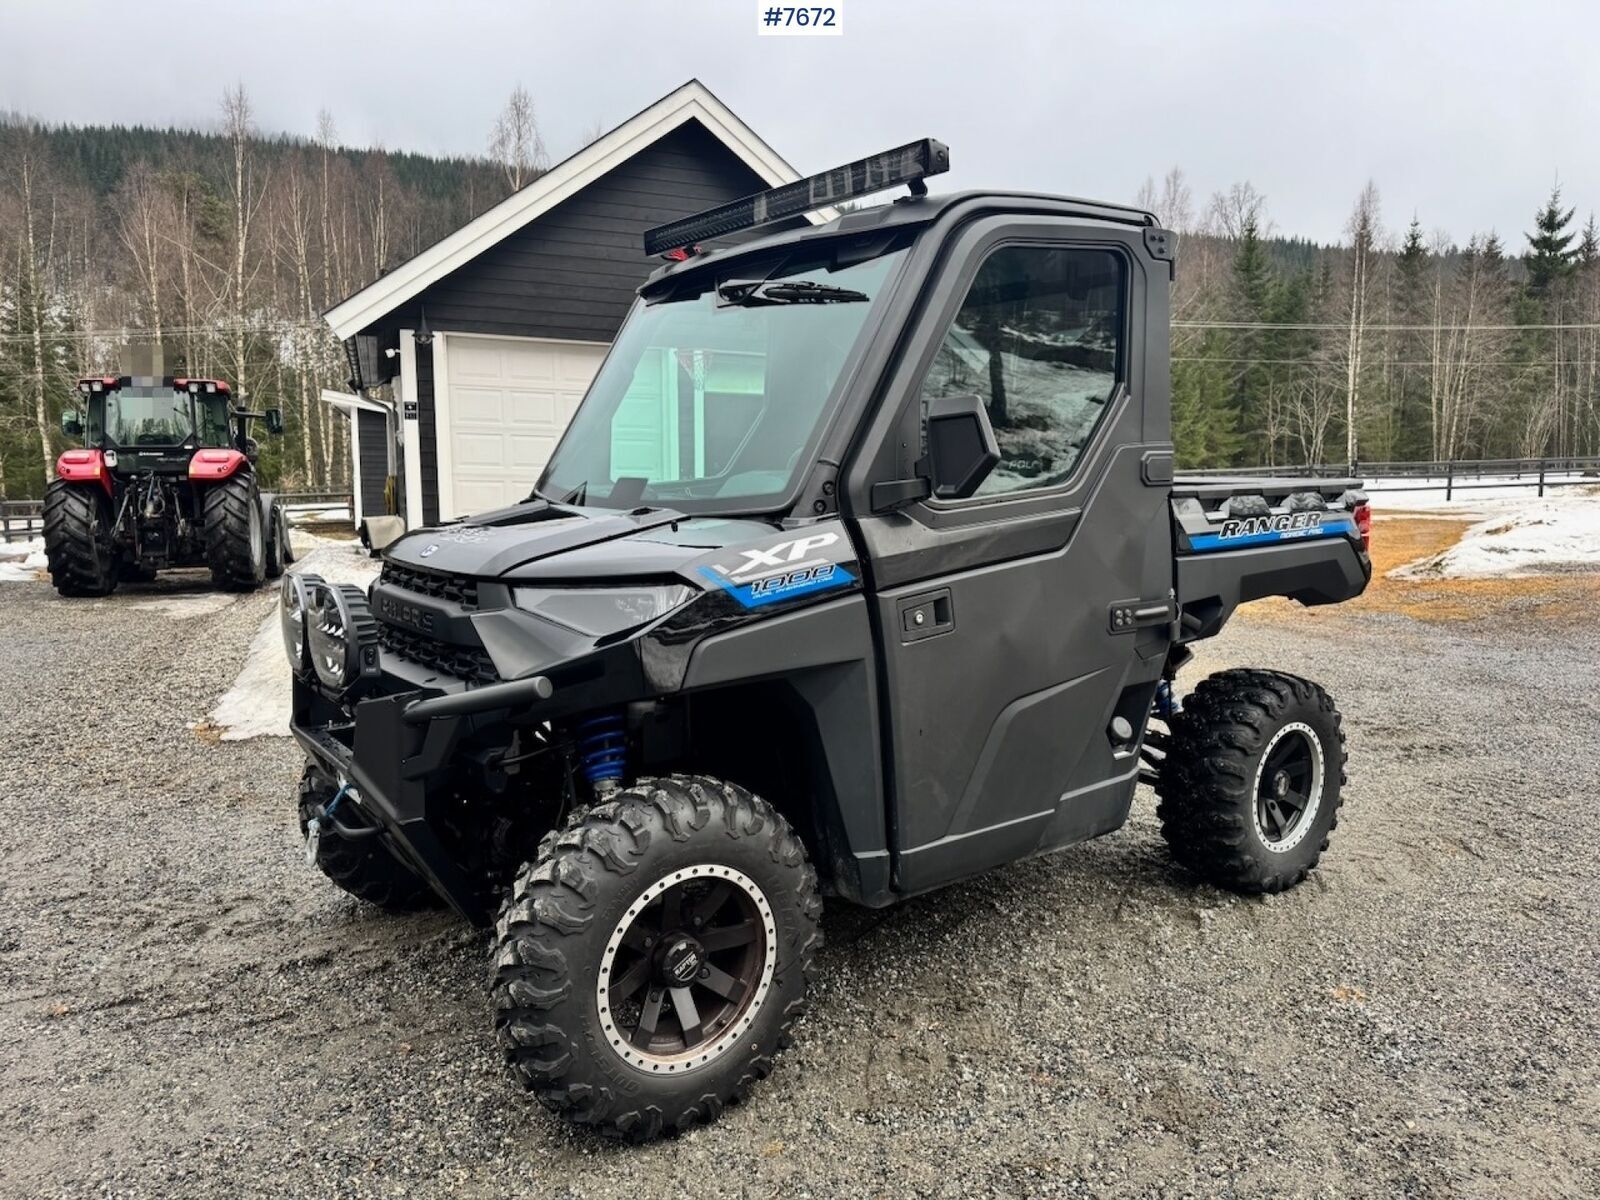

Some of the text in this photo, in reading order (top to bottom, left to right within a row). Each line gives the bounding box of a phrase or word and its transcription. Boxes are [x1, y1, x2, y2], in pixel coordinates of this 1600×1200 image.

[1218, 511, 1322, 539] RANGER
[728, 532, 839, 575] XP
[751, 563, 837, 595] 1000
